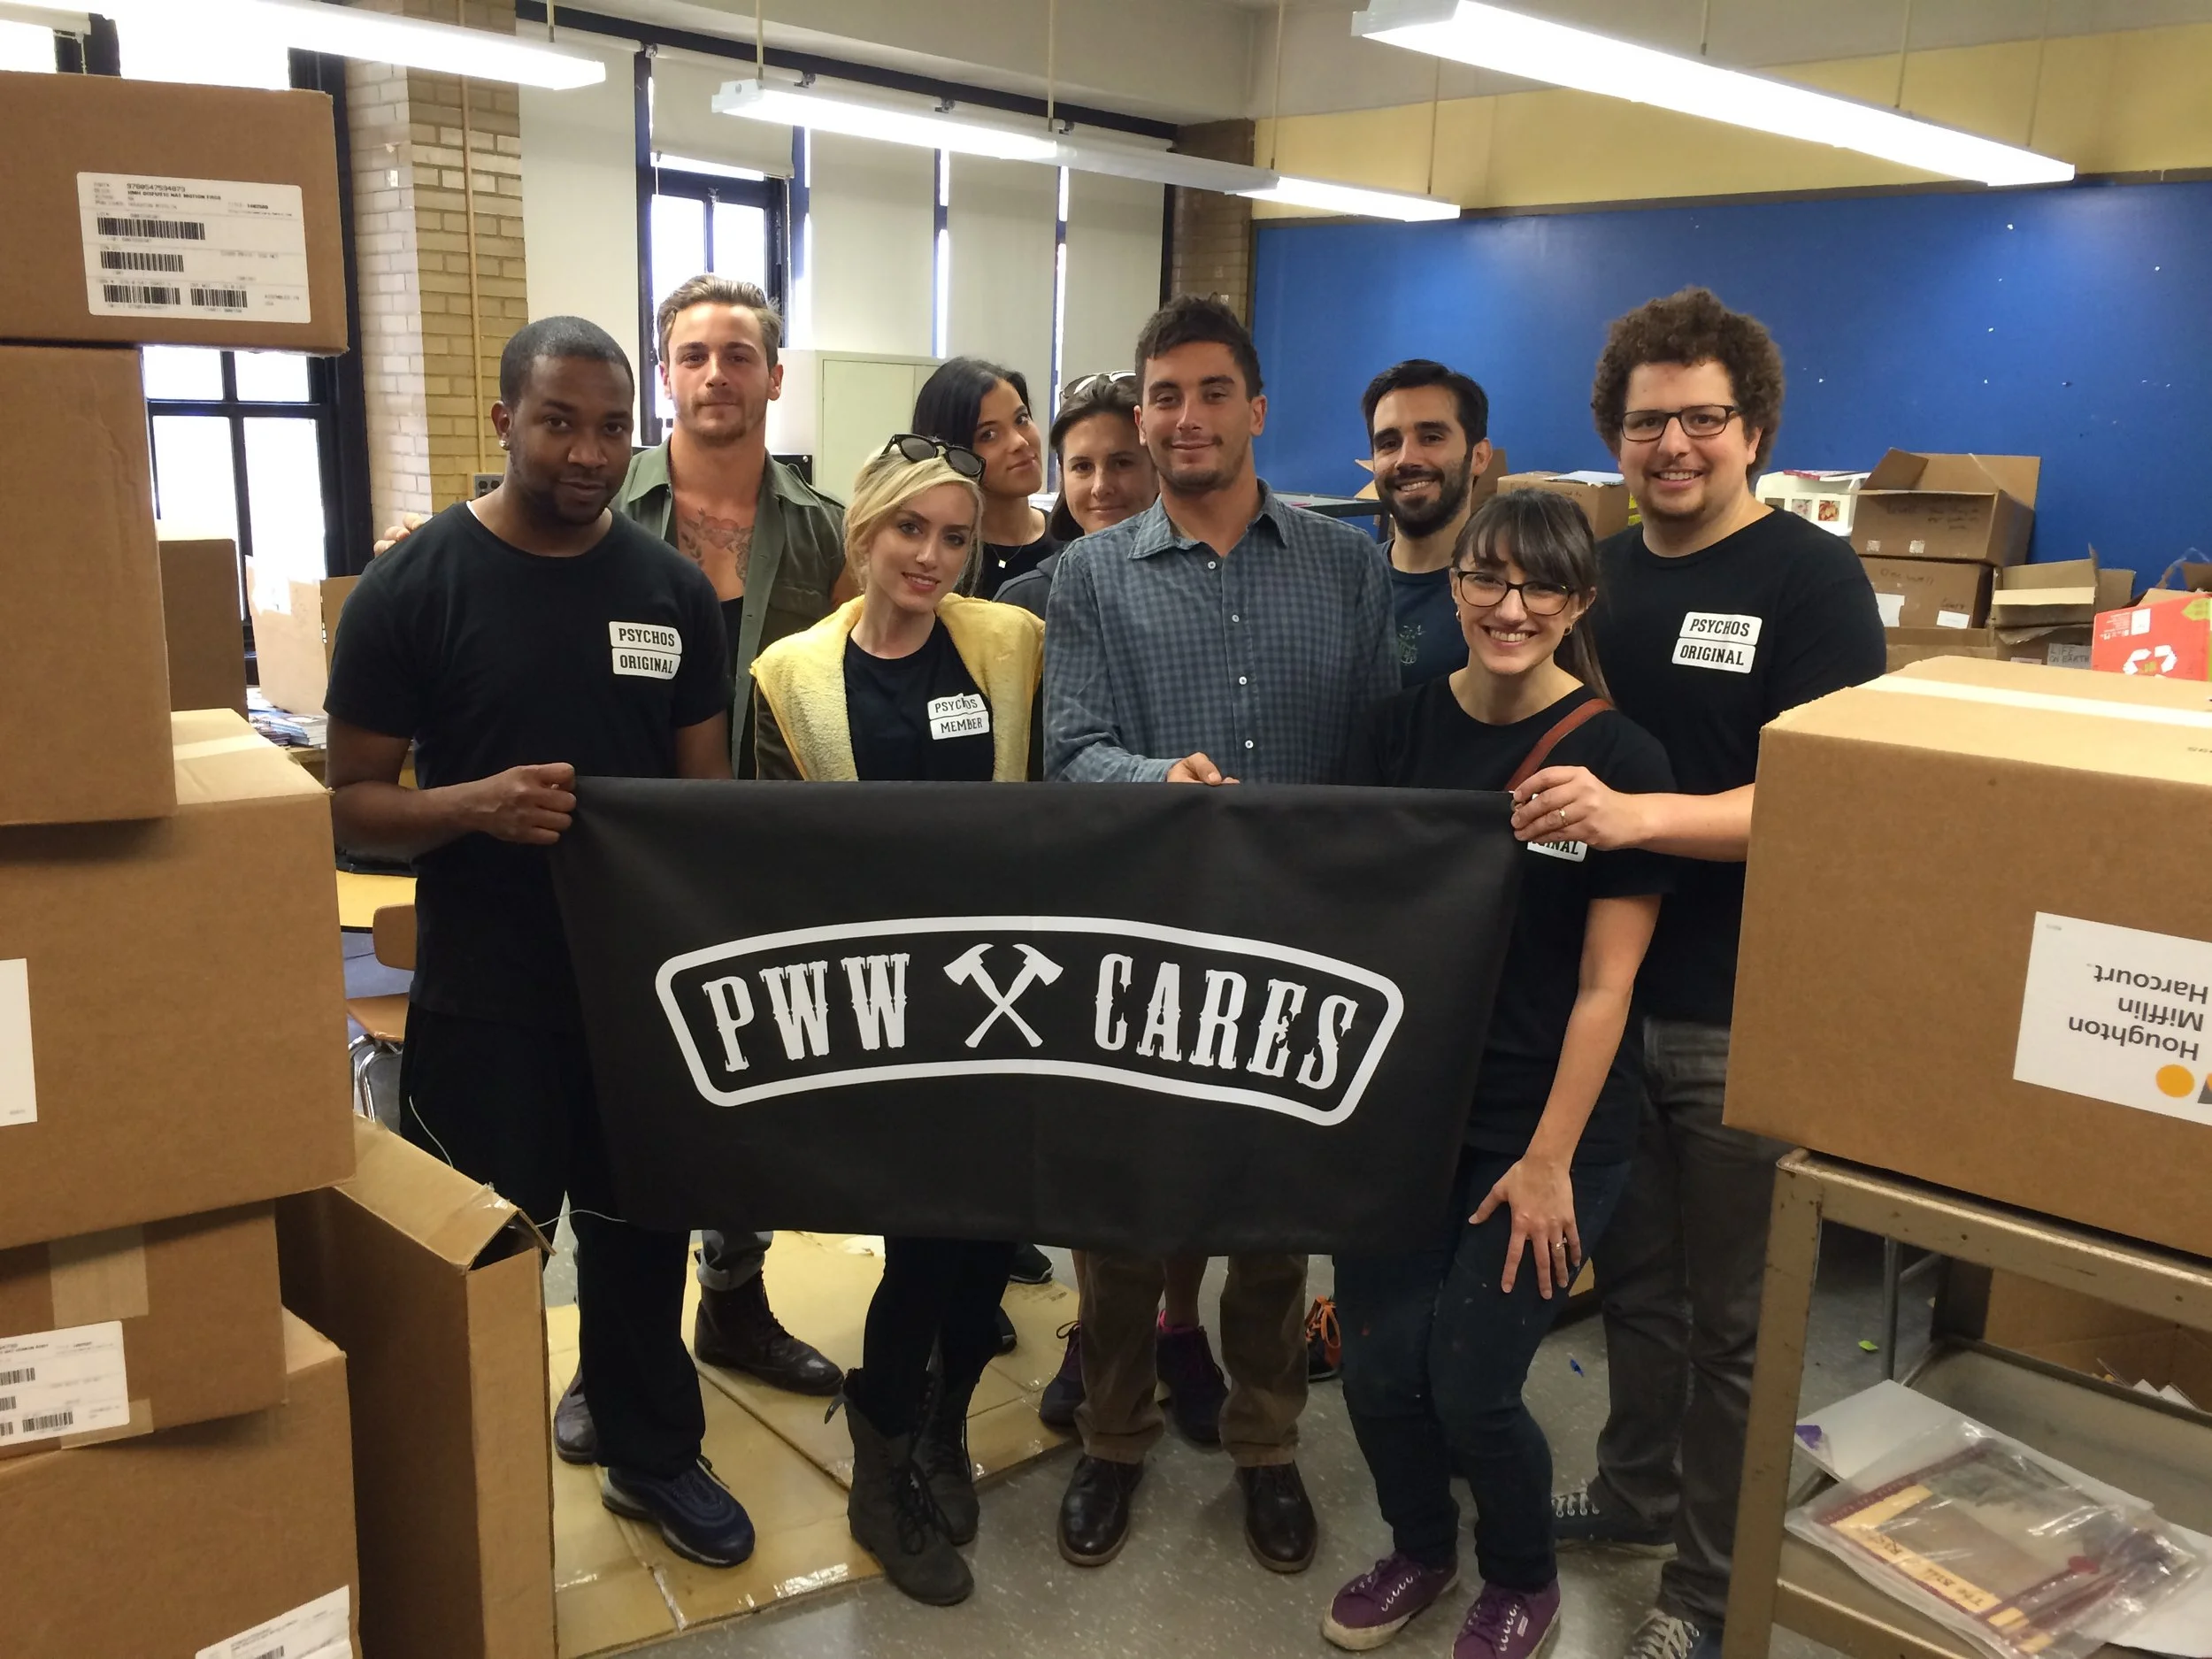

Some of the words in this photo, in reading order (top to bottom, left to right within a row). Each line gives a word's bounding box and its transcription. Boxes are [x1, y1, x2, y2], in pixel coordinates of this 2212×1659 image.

[618, 627, 675, 647] PSYCHOS
[1689, 618, 1750, 637] PSYCHOS
[619, 655, 673, 674] ORIGINAL
[1679, 644, 1744, 666] ORIGINAL
[934, 697, 978, 713] PSYCHOS
[941, 717, 983, 733] MEMBER
[2093, 964, 2208, 1004] Harcourt
[702, 952, 910, 1072] PWW
[1094, 953, 1359, 1090] CARES
[2117, 997, 2204, 1032] Mifflin
[2068, 1017, 2200, 1061] Houghton
